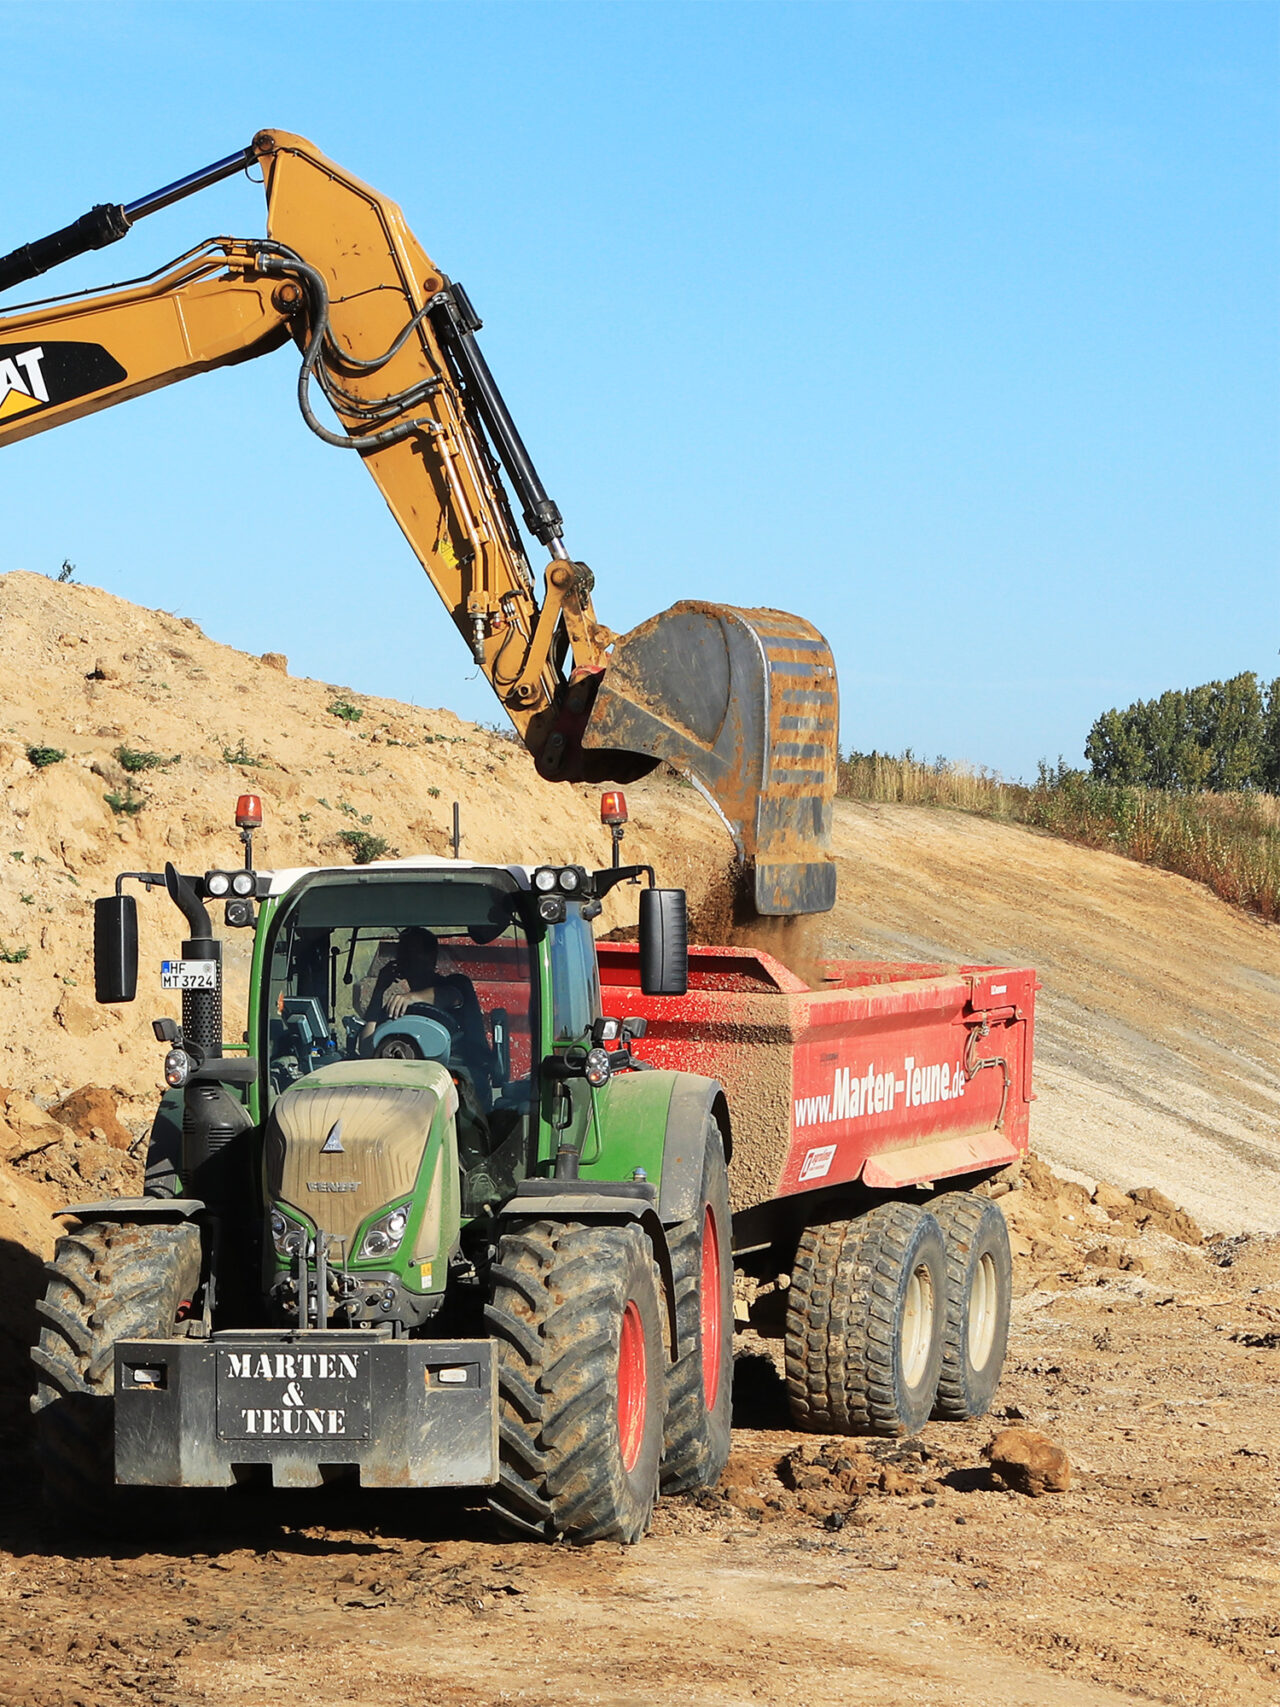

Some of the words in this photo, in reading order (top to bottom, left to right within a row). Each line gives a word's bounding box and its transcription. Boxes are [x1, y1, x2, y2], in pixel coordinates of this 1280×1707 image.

[170, 962, 186, 974] HF
[163, 975, 179, 987] MT
[182, 975, 212, 987] 3724
[795, 1056, 965, 1127] www.Marten-Teune.de
[228, 1354, 359, 1378] MARTEN
[282, 1381, 305, 1406] &
[241, 1409, 346, 1434] TEUNE
